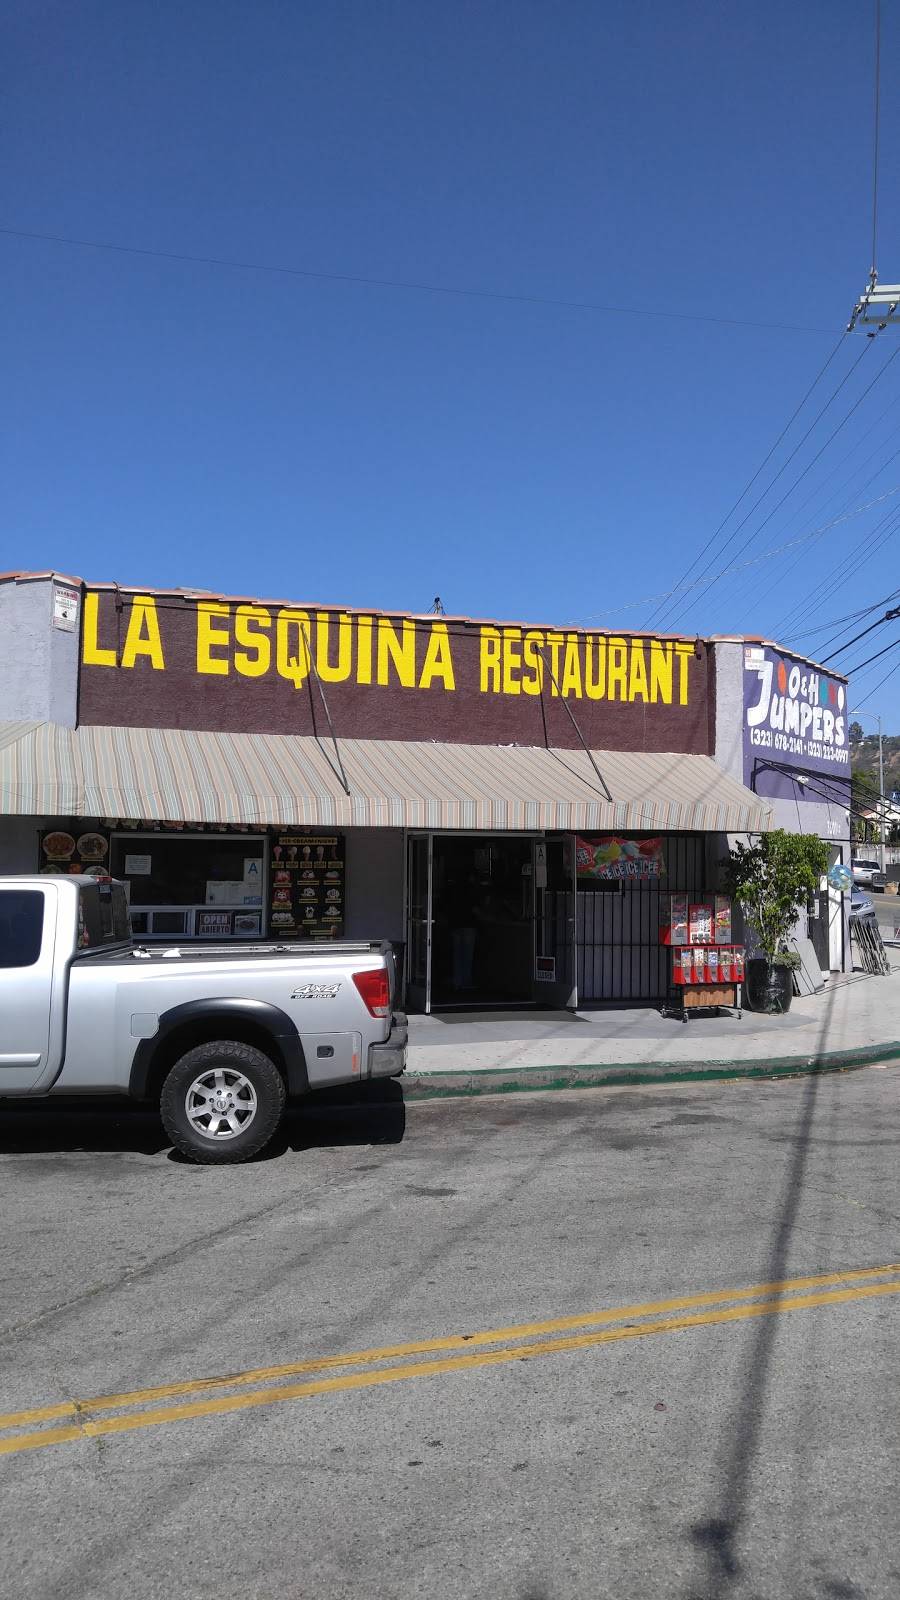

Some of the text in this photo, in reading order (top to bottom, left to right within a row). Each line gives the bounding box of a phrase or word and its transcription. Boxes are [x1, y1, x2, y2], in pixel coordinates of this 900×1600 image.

[82, 592, 696, 706] LA ESQUINA RESTAURANT
[746, 660, 845, 746] JUMPERS
[750, 727, 773, 748] (323)
[774, 732, 803, 755] 678-2141
[807, 741, 823, 758] (323)
[247, 862, 258, 874] A
[199, 925, 231, 934] ABIERTO
[203, 914, 228, 925] OPEN
